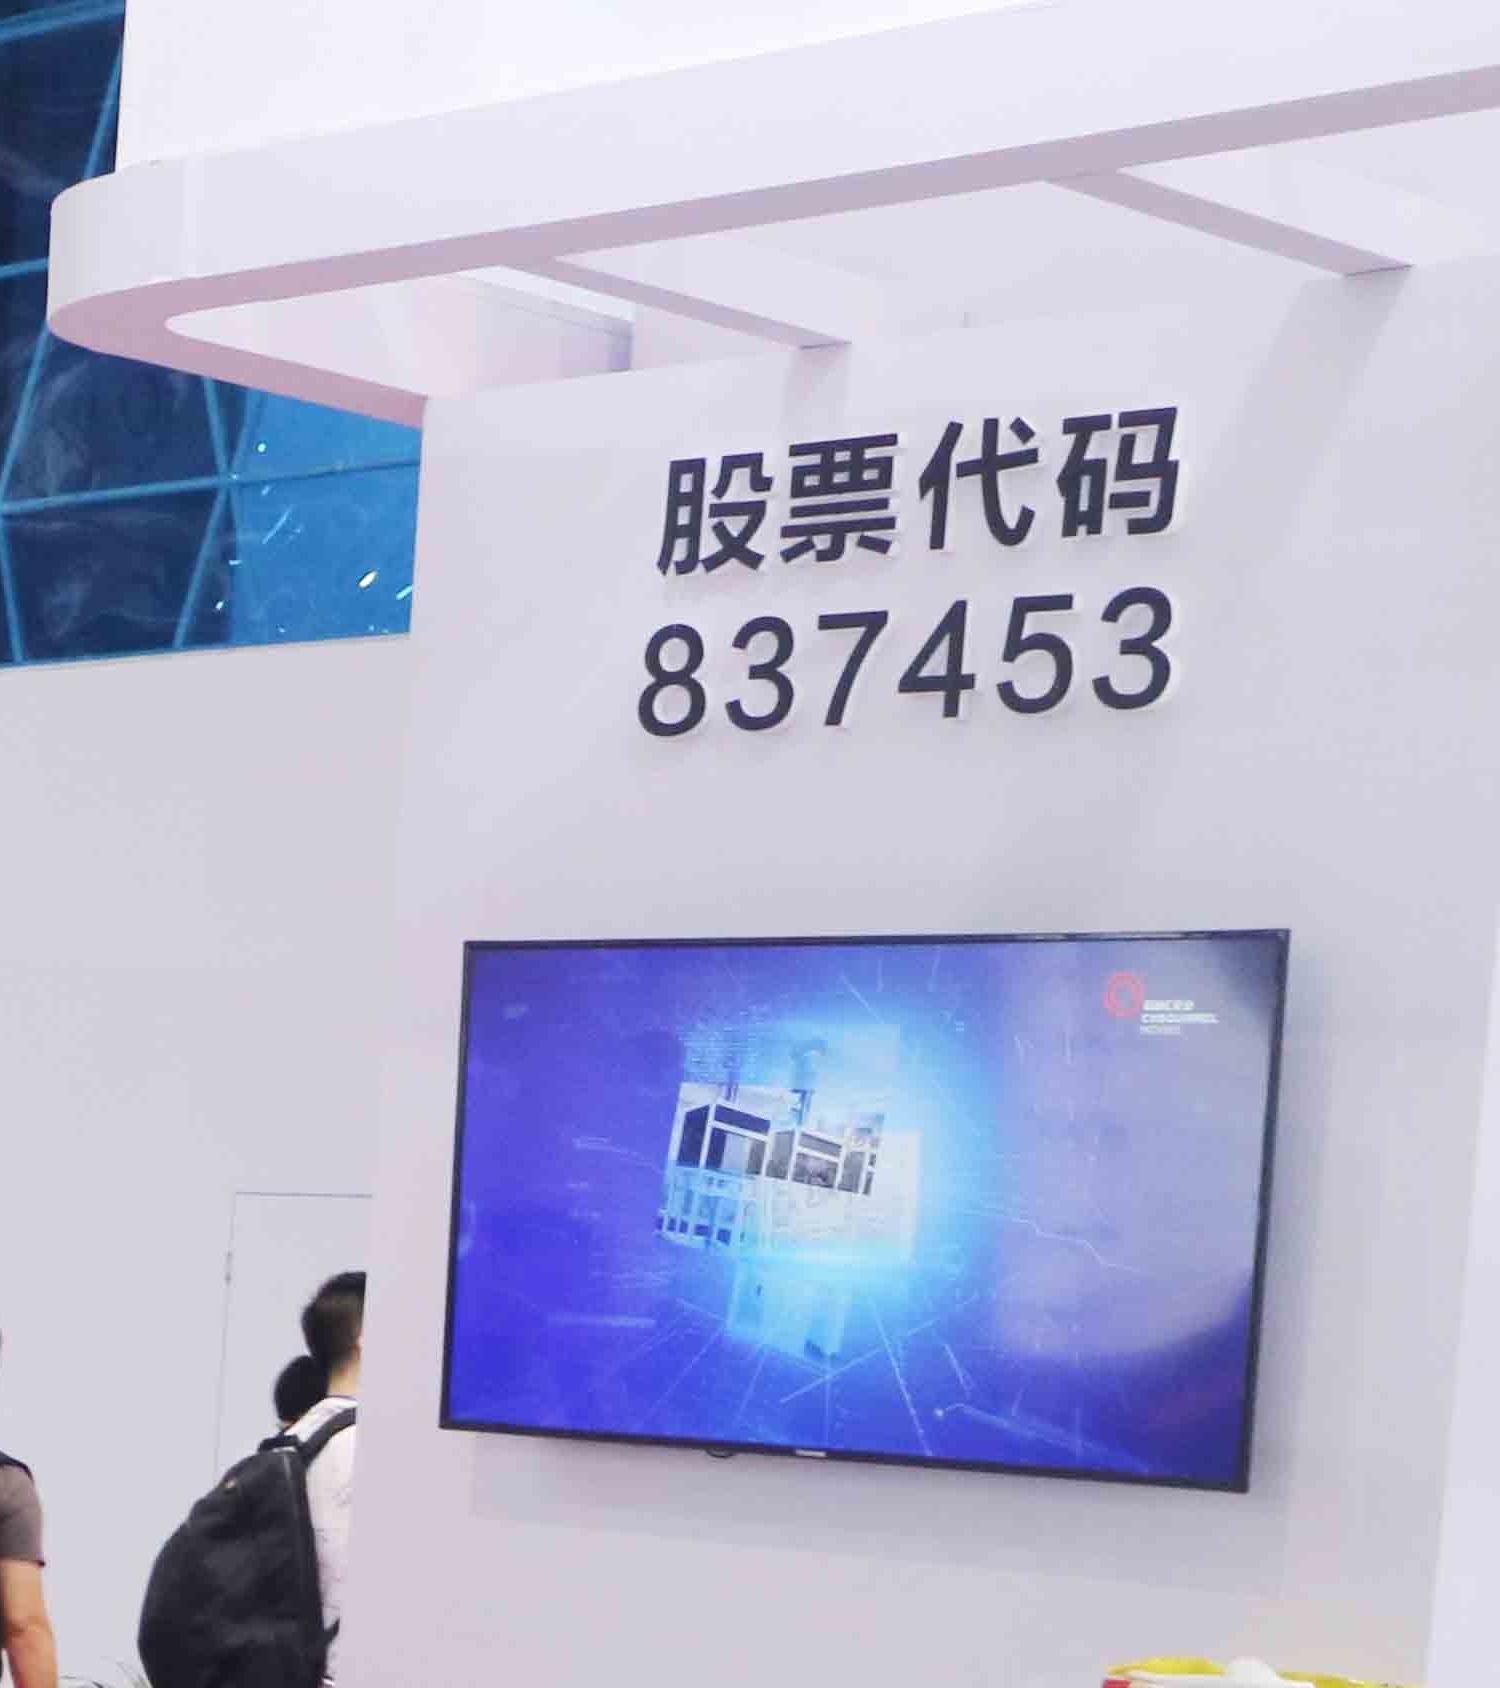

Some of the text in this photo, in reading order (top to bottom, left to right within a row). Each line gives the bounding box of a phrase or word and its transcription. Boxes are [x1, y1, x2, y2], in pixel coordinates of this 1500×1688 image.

[657, 406, 1180, 577] 股票代码
[637, 586, 1174, 738] 837453
